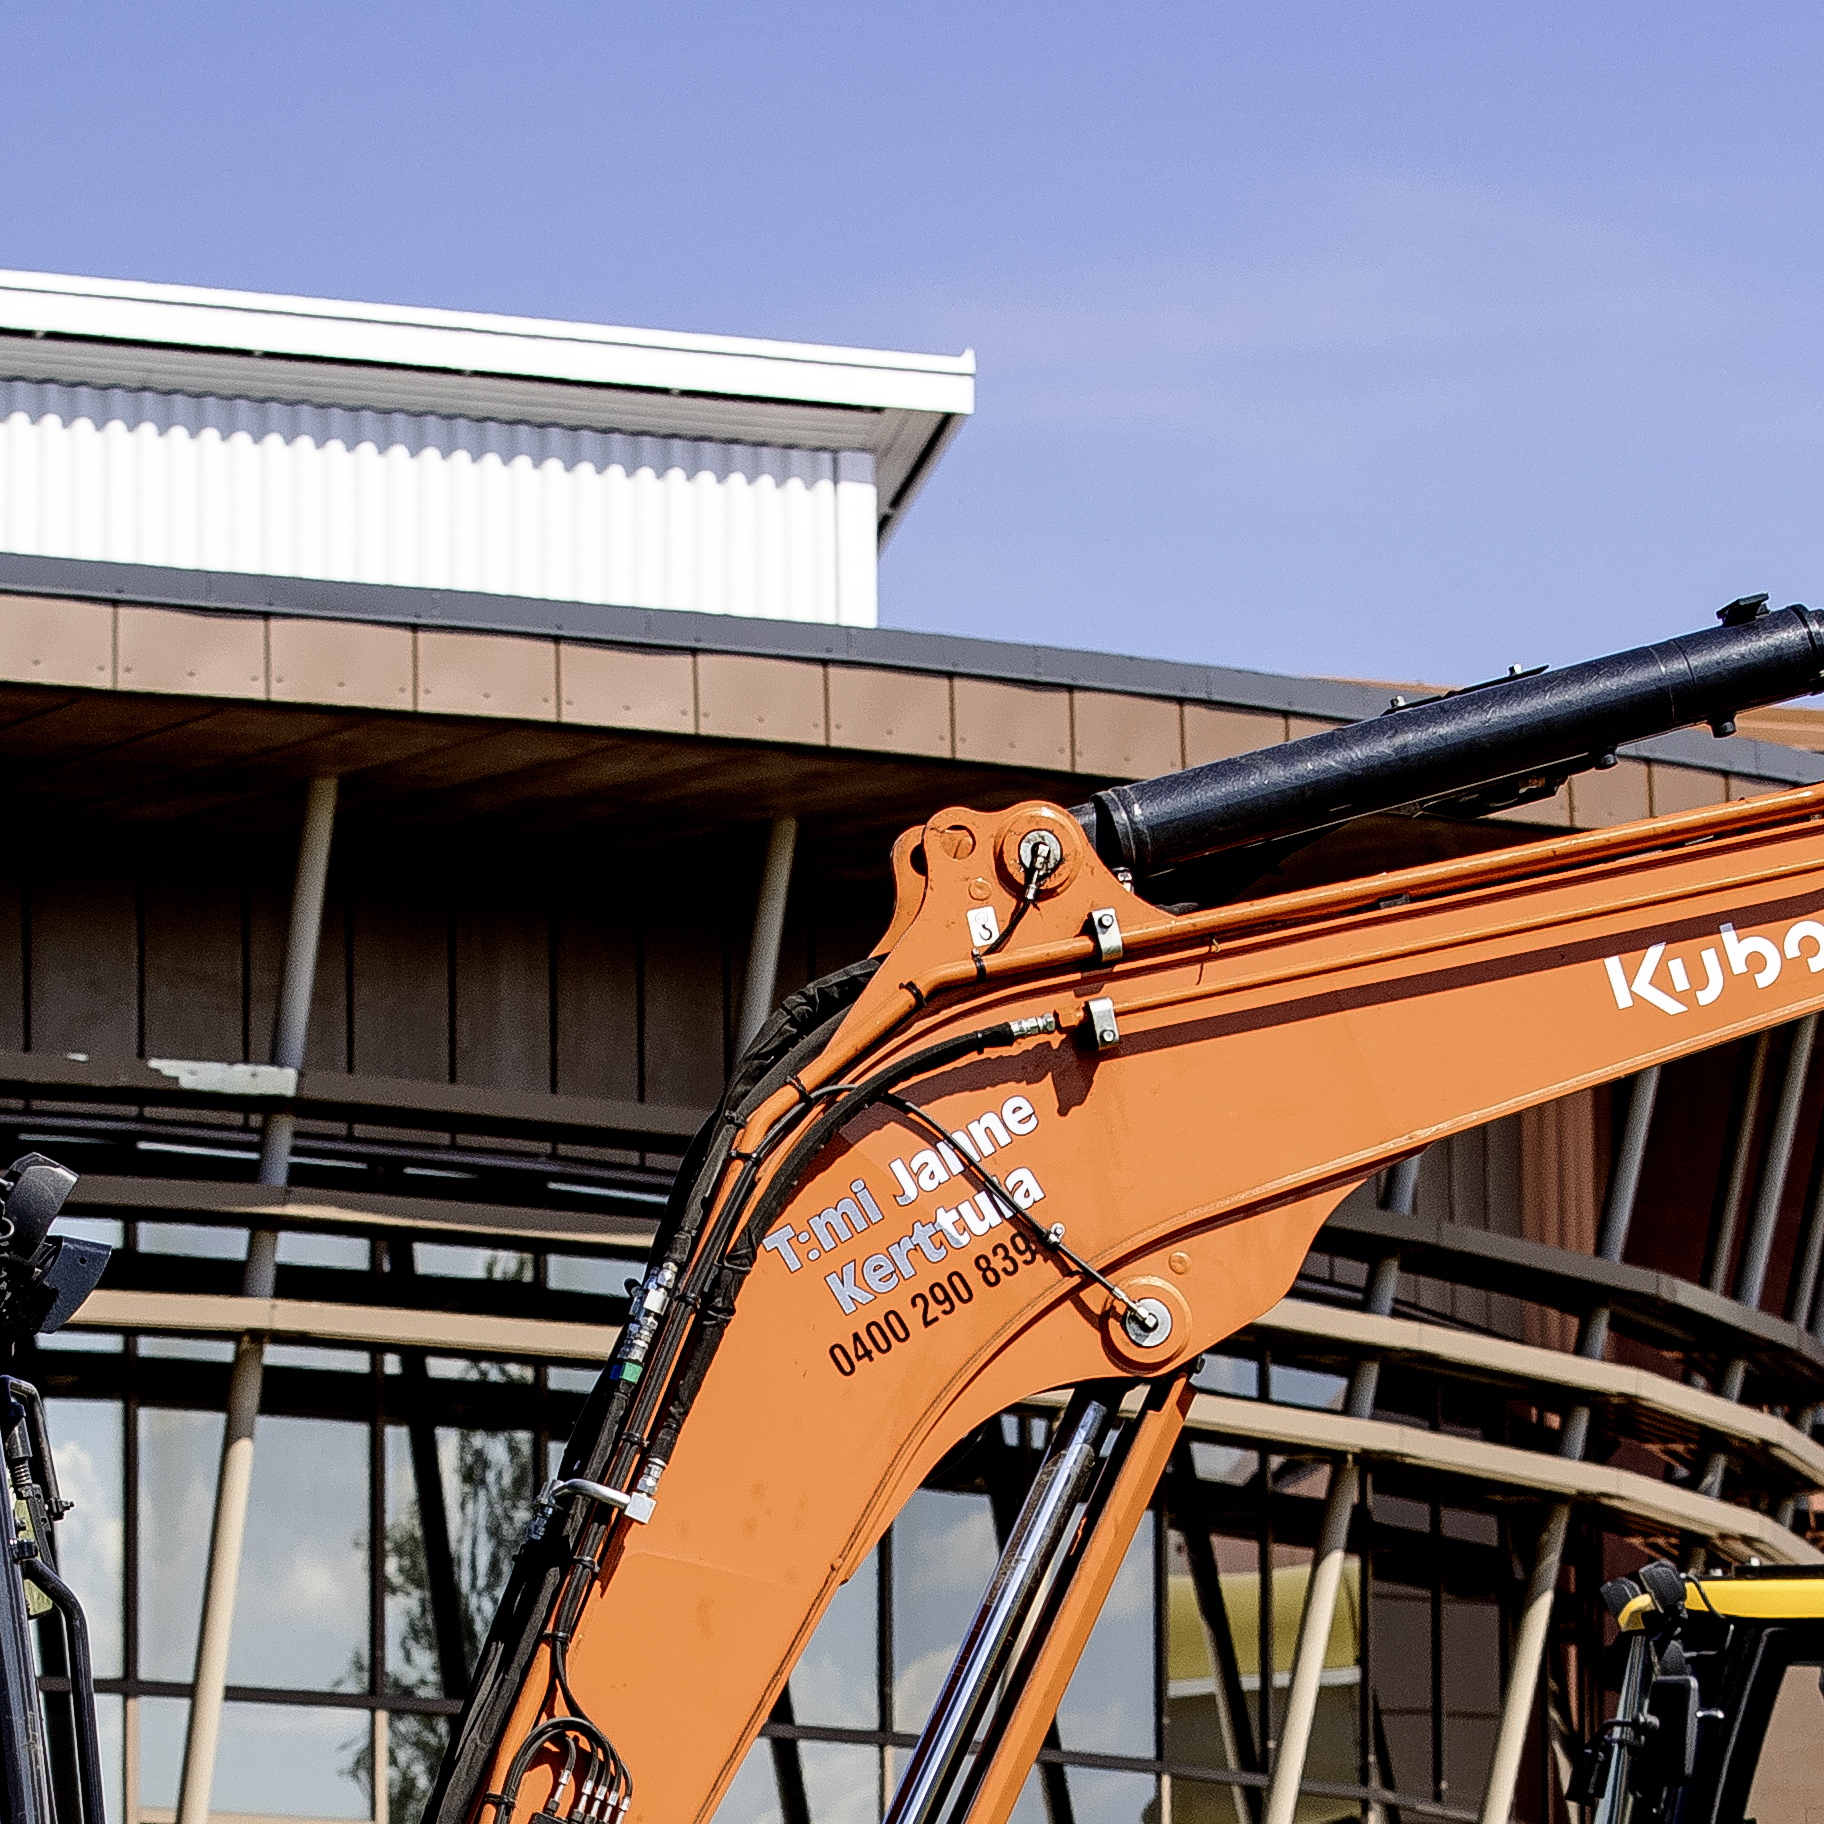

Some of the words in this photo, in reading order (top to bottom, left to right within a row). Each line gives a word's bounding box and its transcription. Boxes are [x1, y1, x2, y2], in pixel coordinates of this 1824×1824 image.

[762, 1178, 884, 1274] T:mi
[889, 1095, 1039, 1206] Janne
[828, 1309, 911, 1378] 0400
[910, 1271, 974, 1329] 290
[973, 1231, 1038, 1289] 839
